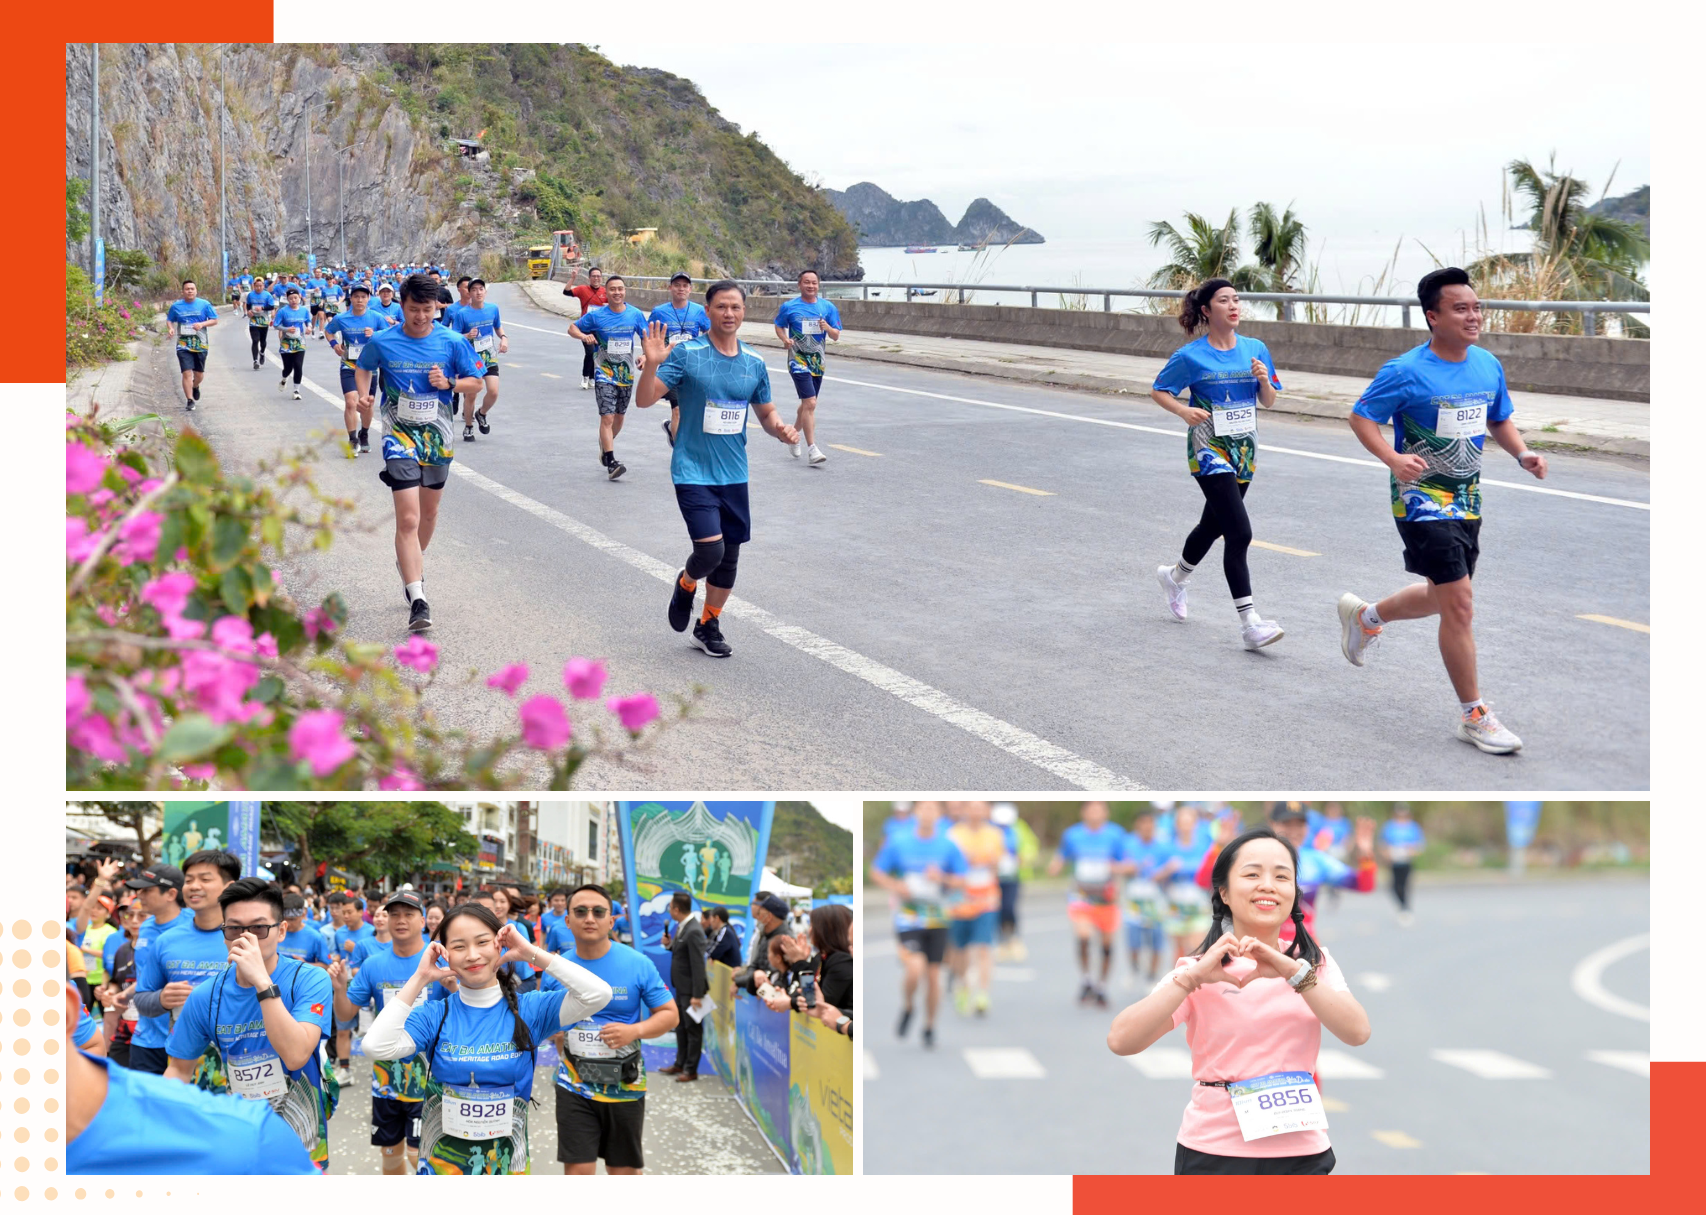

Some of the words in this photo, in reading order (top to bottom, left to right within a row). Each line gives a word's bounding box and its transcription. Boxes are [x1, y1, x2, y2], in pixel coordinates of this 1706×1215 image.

[409, 401, 435, 410] 8399
[721, 411, 741, 420] 8116
[1226, 409, 1252, 421] 8525
[1457, 407, 1482, 422] 8122
[440, 1042, 458, 1055] CAT
[459, 1045, 475, 1055] BA
[458, 1055, 490, 1063] HERITAGE
[491, 1053, 509, 1062] ROAD
[233, 1063, 274, 1082] 8572
[1257, 1088, 1313, 1110] 8856
[459, 1102, 506, 1118] 8928
